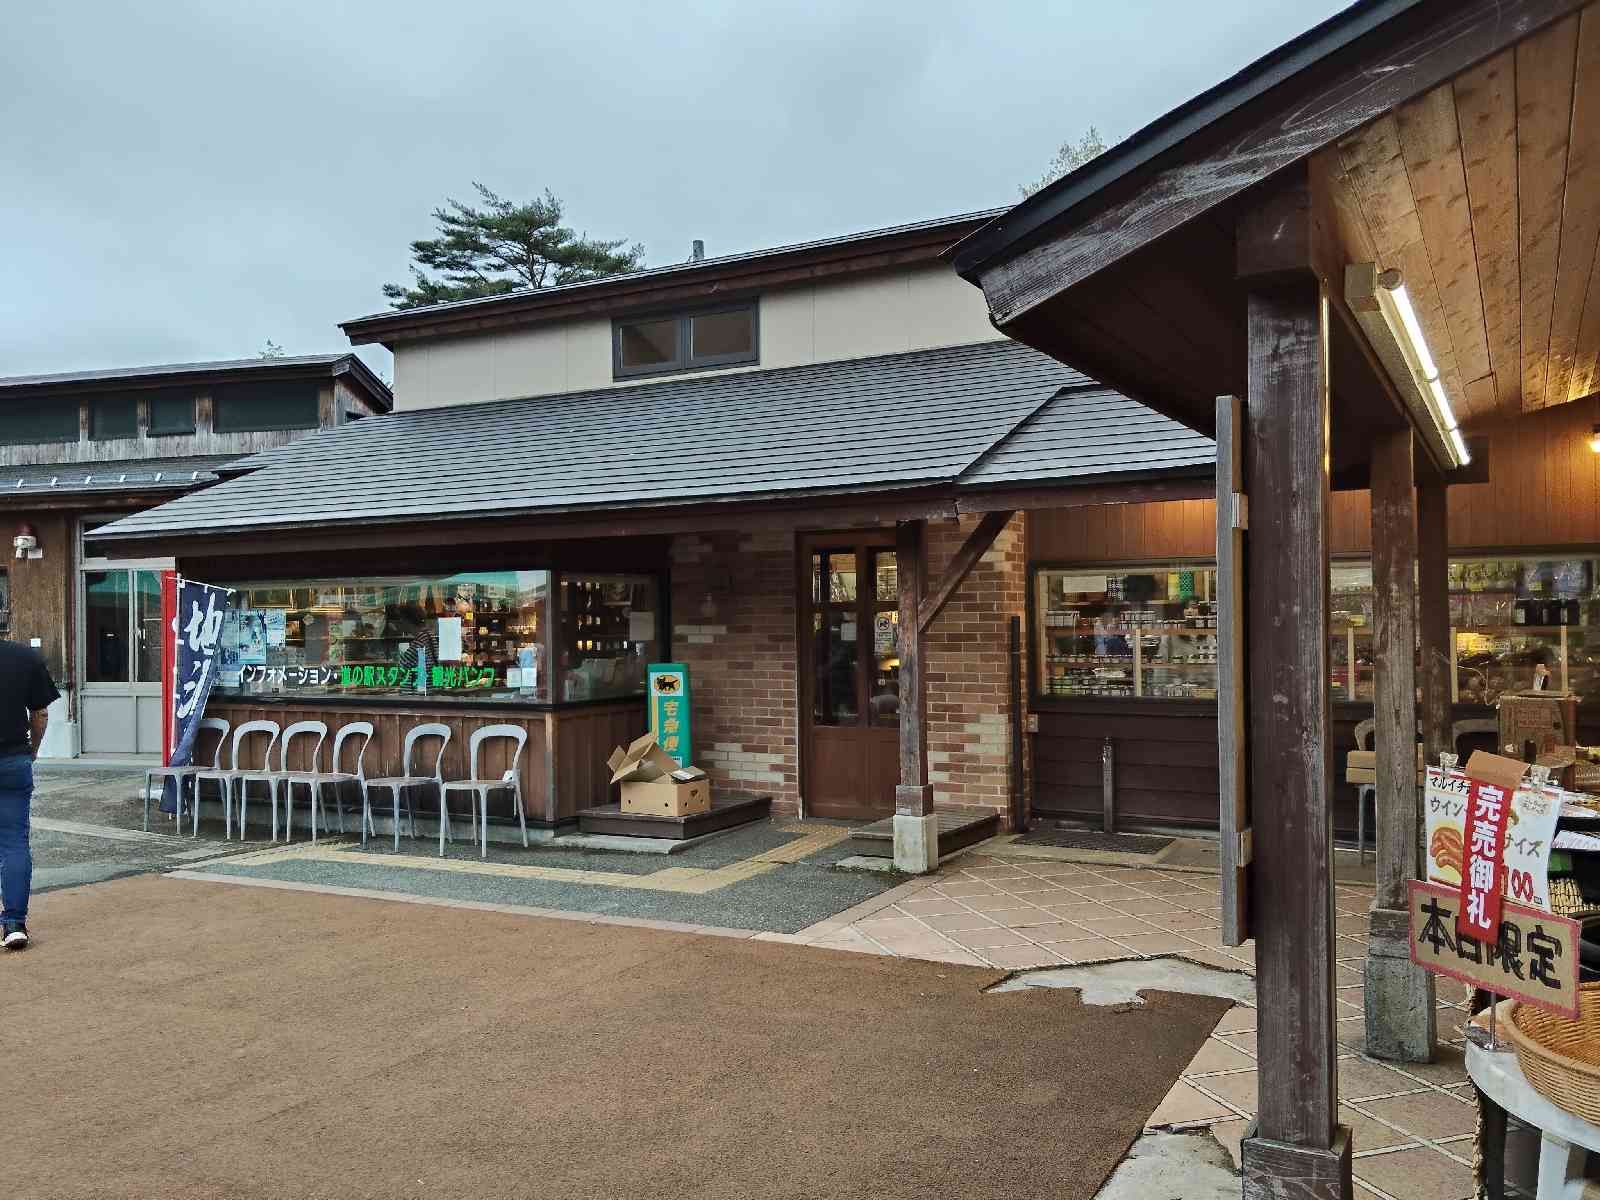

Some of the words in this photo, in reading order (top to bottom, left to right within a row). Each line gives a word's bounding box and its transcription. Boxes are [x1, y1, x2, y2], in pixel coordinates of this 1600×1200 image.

[1466, 784, 1504, 930] 完売御礼
[1418, 897, 1563, 990] 本日限定
